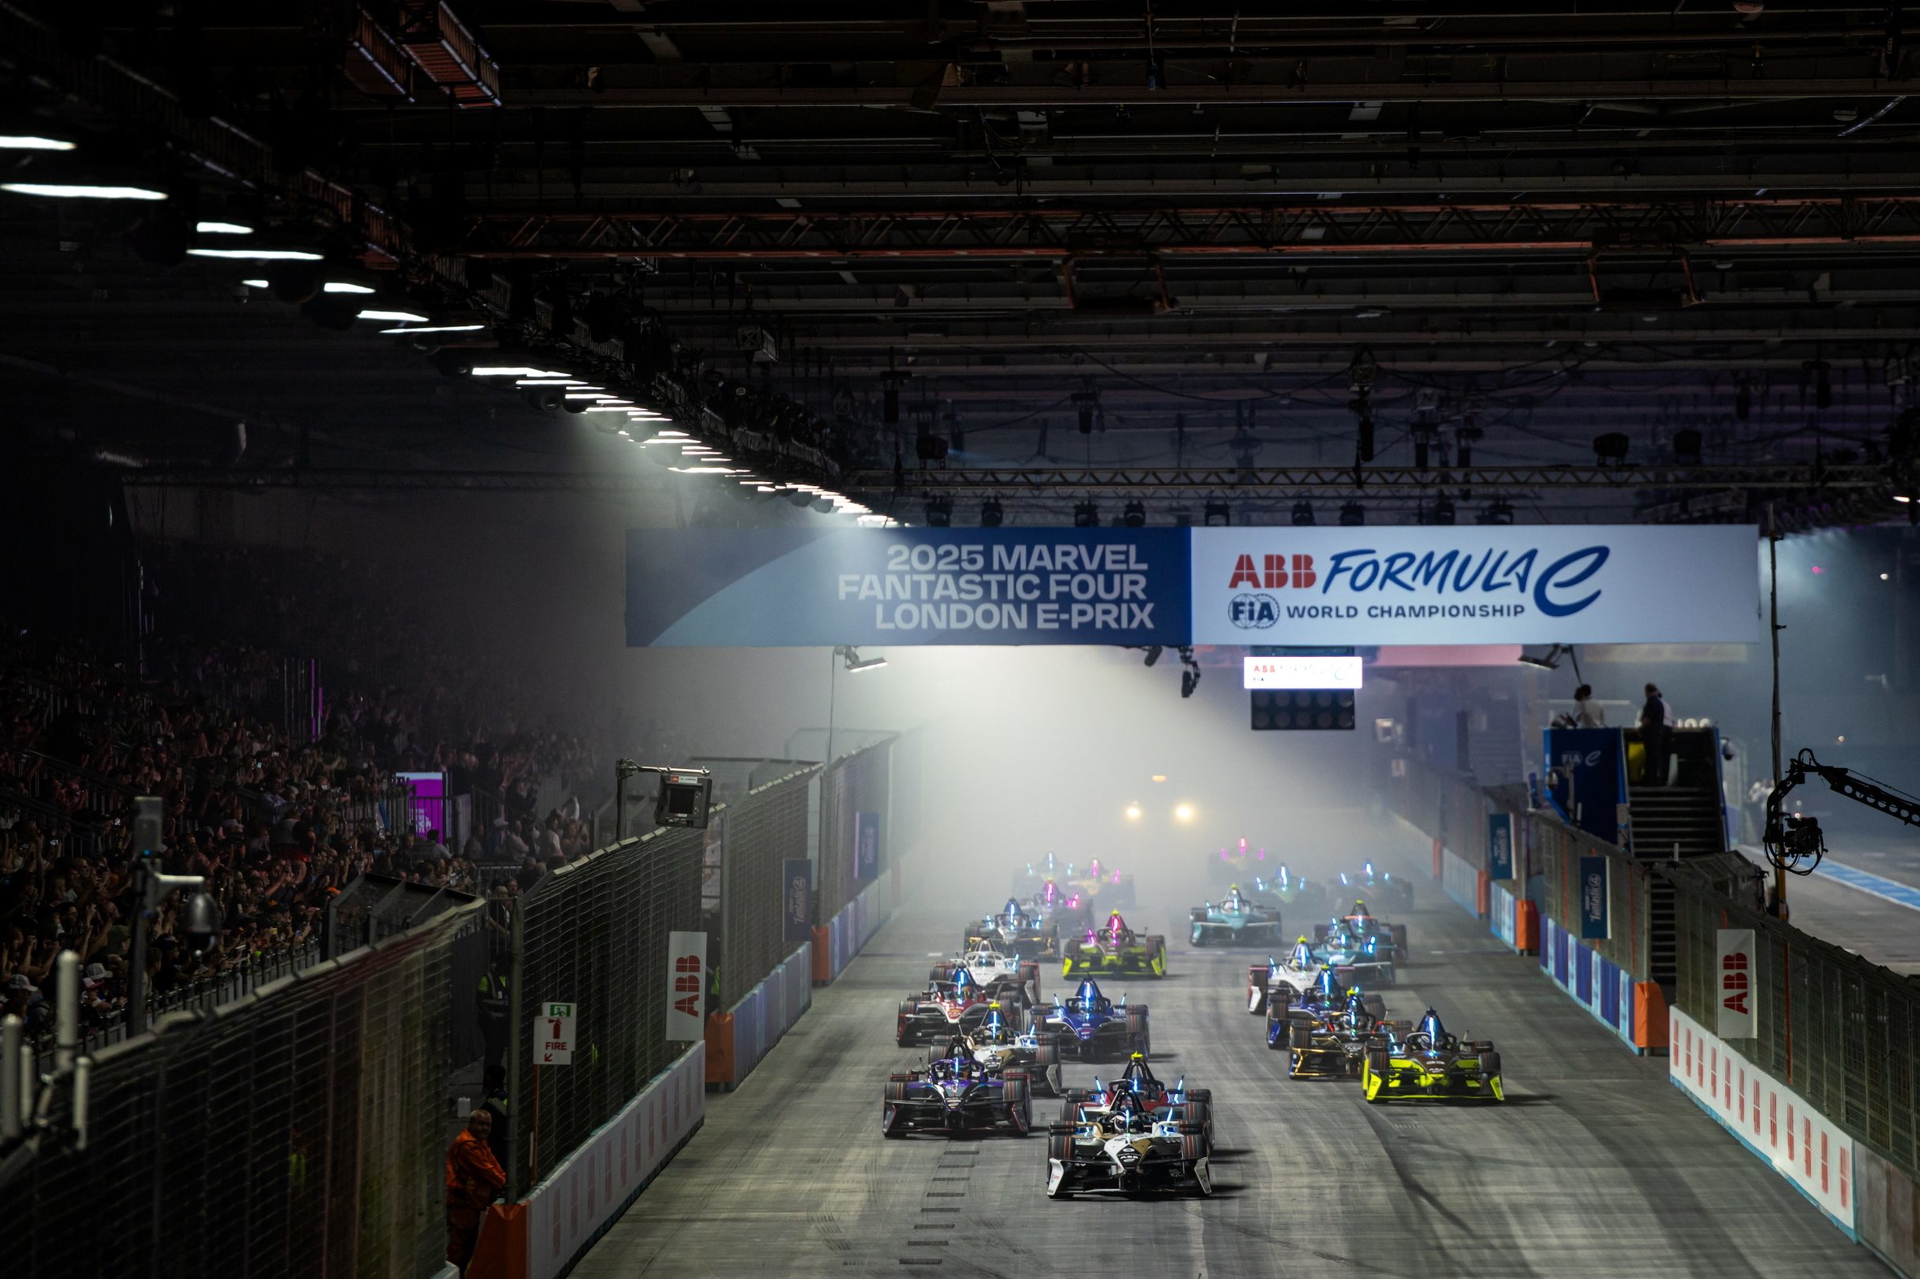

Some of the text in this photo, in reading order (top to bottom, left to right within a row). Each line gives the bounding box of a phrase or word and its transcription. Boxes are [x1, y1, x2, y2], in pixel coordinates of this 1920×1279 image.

[887, 544, 1149, 571] 2025 MARVEL
[1228, 554, 1317, 589] ABB
[1322, 547, 1539, 595] FORMULA
[838, 574, 1147, 601] FANTASTIC FOUR
[875, 603, 1155, 630] LONDON E-PRIX
[1286, 604, 1358, 619] WORLD
[1367, 603, 1526, 619] CHAMPIONSHIP
[1253, 665, 1275, 673] ABB
[674, 955, 701, 1019] ABB
[1723, 952, 1749, 1015] ABB
[545, 1041, 568, 1051] FIRE
